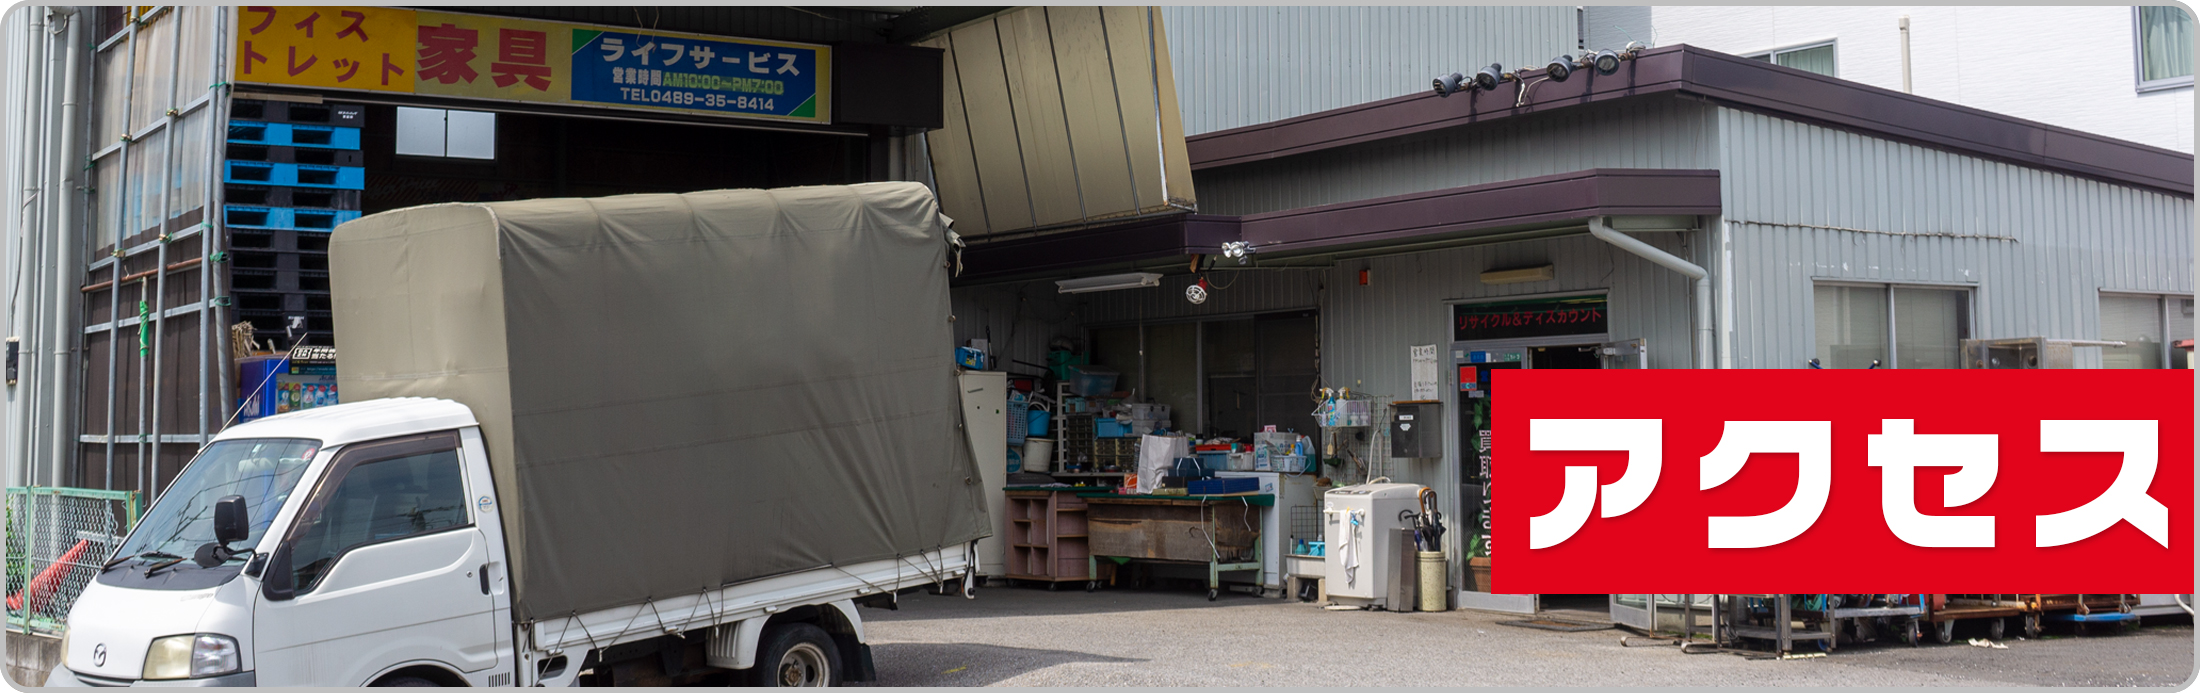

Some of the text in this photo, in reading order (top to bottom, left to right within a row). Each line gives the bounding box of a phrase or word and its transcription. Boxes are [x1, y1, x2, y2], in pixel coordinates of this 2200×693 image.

[247, 6, 370, 43] フィス
[243, 40, 405, 86] トレット
[417, 23, 552, 92] 家具
[600, 37, 800, 77] ライフサービス
[620, 87, 775, 112] TEL0489-35-8414
[1459, 307, 1602, 330] リサイクル&ディスカウント
